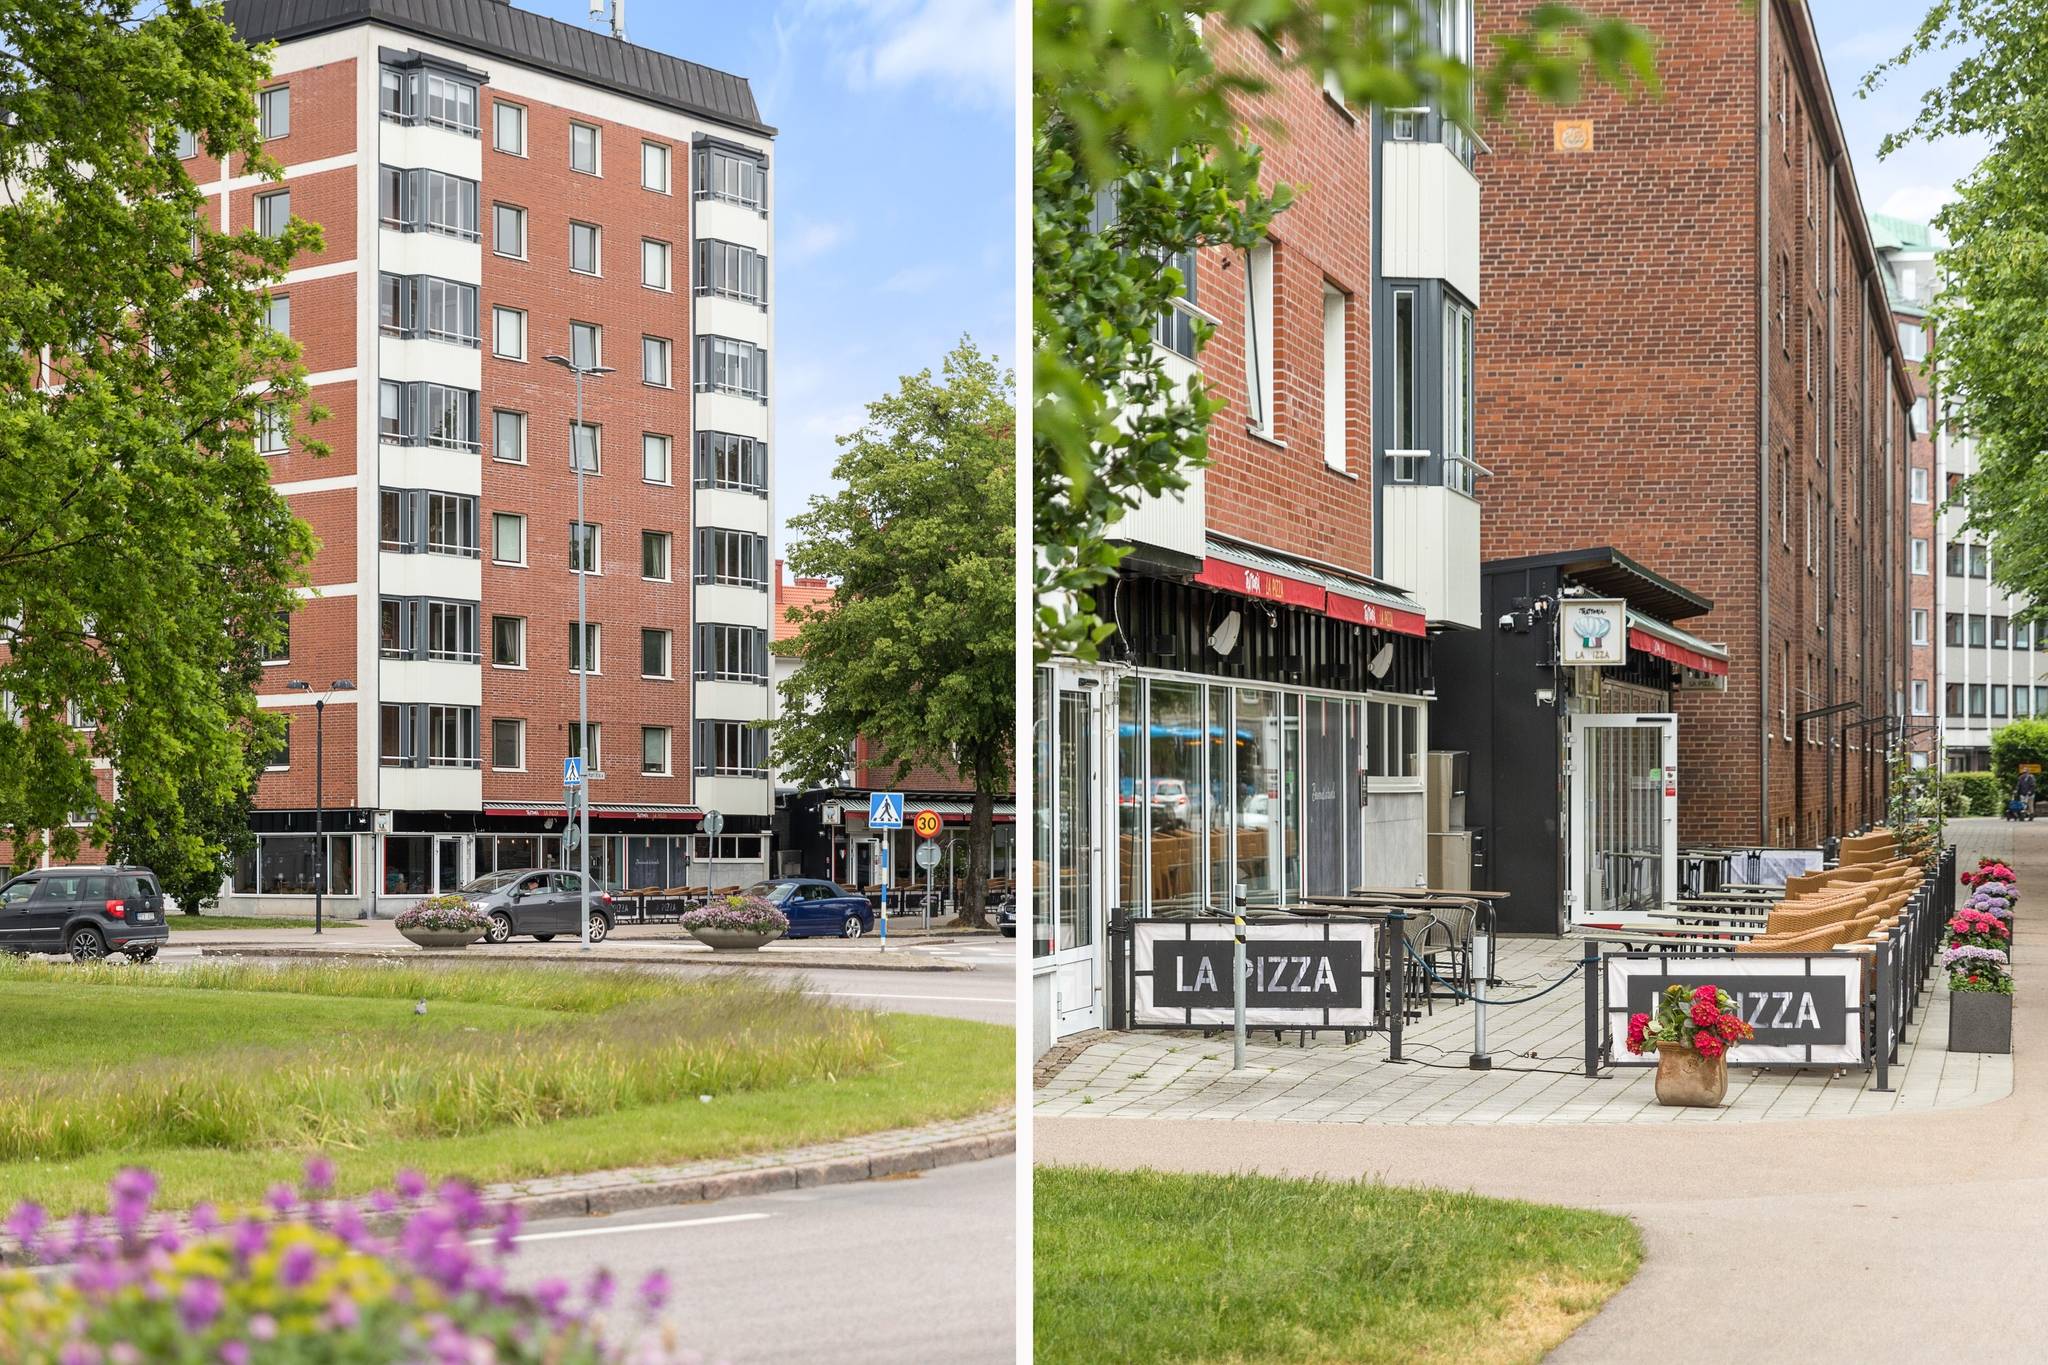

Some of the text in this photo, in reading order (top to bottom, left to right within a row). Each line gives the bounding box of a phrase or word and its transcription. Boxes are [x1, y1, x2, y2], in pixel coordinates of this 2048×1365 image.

[1590, 650, 1610, 660] IZZA
[919, 817, 937, 831] 30
[1176, 955, 1218, 993] LA
[1736, 991, 1821, 1029] IZZA
